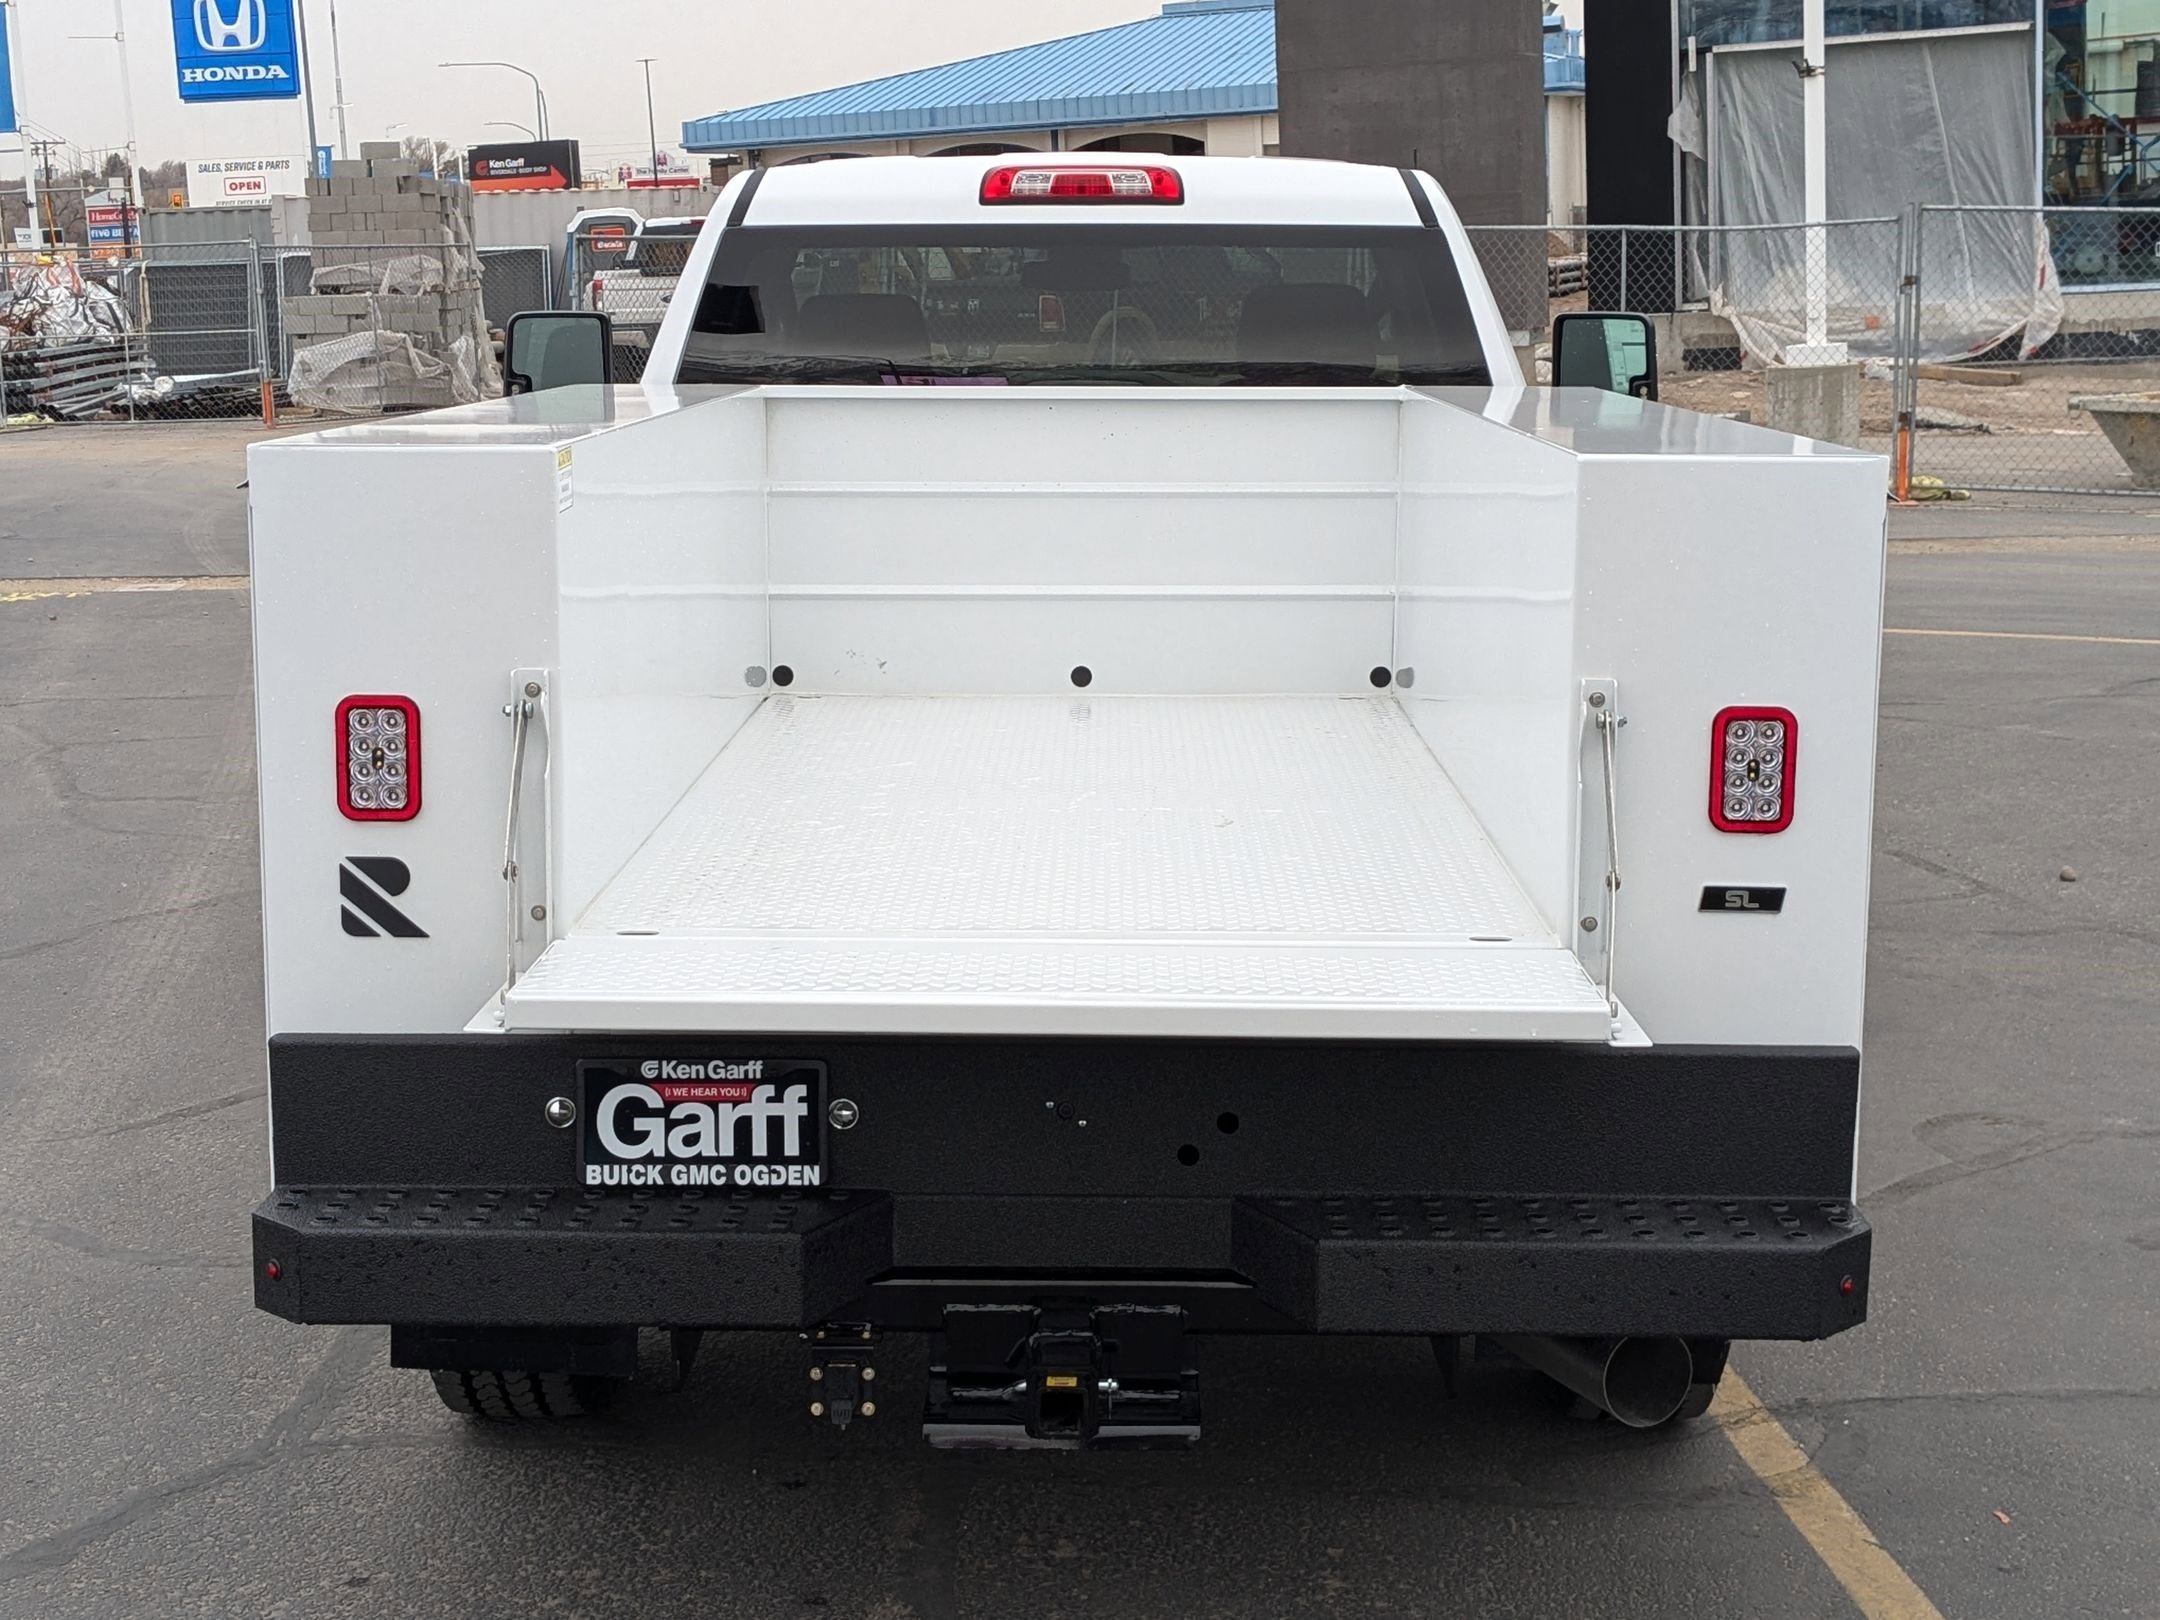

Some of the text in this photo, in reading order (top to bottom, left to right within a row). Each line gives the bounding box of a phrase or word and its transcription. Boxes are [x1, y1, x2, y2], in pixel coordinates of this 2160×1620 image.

[182, 65, 290, 83] HONDA
[198, 162, 223, 174] SALES,
[224, 161, 258, 172] SERVICE
[265, 160, 290, 170] PARTS
[489, 157, 525, 168] Ken Garff
[229, 181, 262, 191] OPEN
[1725, 889, 1760, 908] SL
[661, 1060, 763, 1079] Ken Garff
[672, 1087, 740, 1097] WE HEAR YOU
[597, 1083, 808, 1159] Garff
[586, 1164, 820, 1186] BUICK GMC OGDEN
